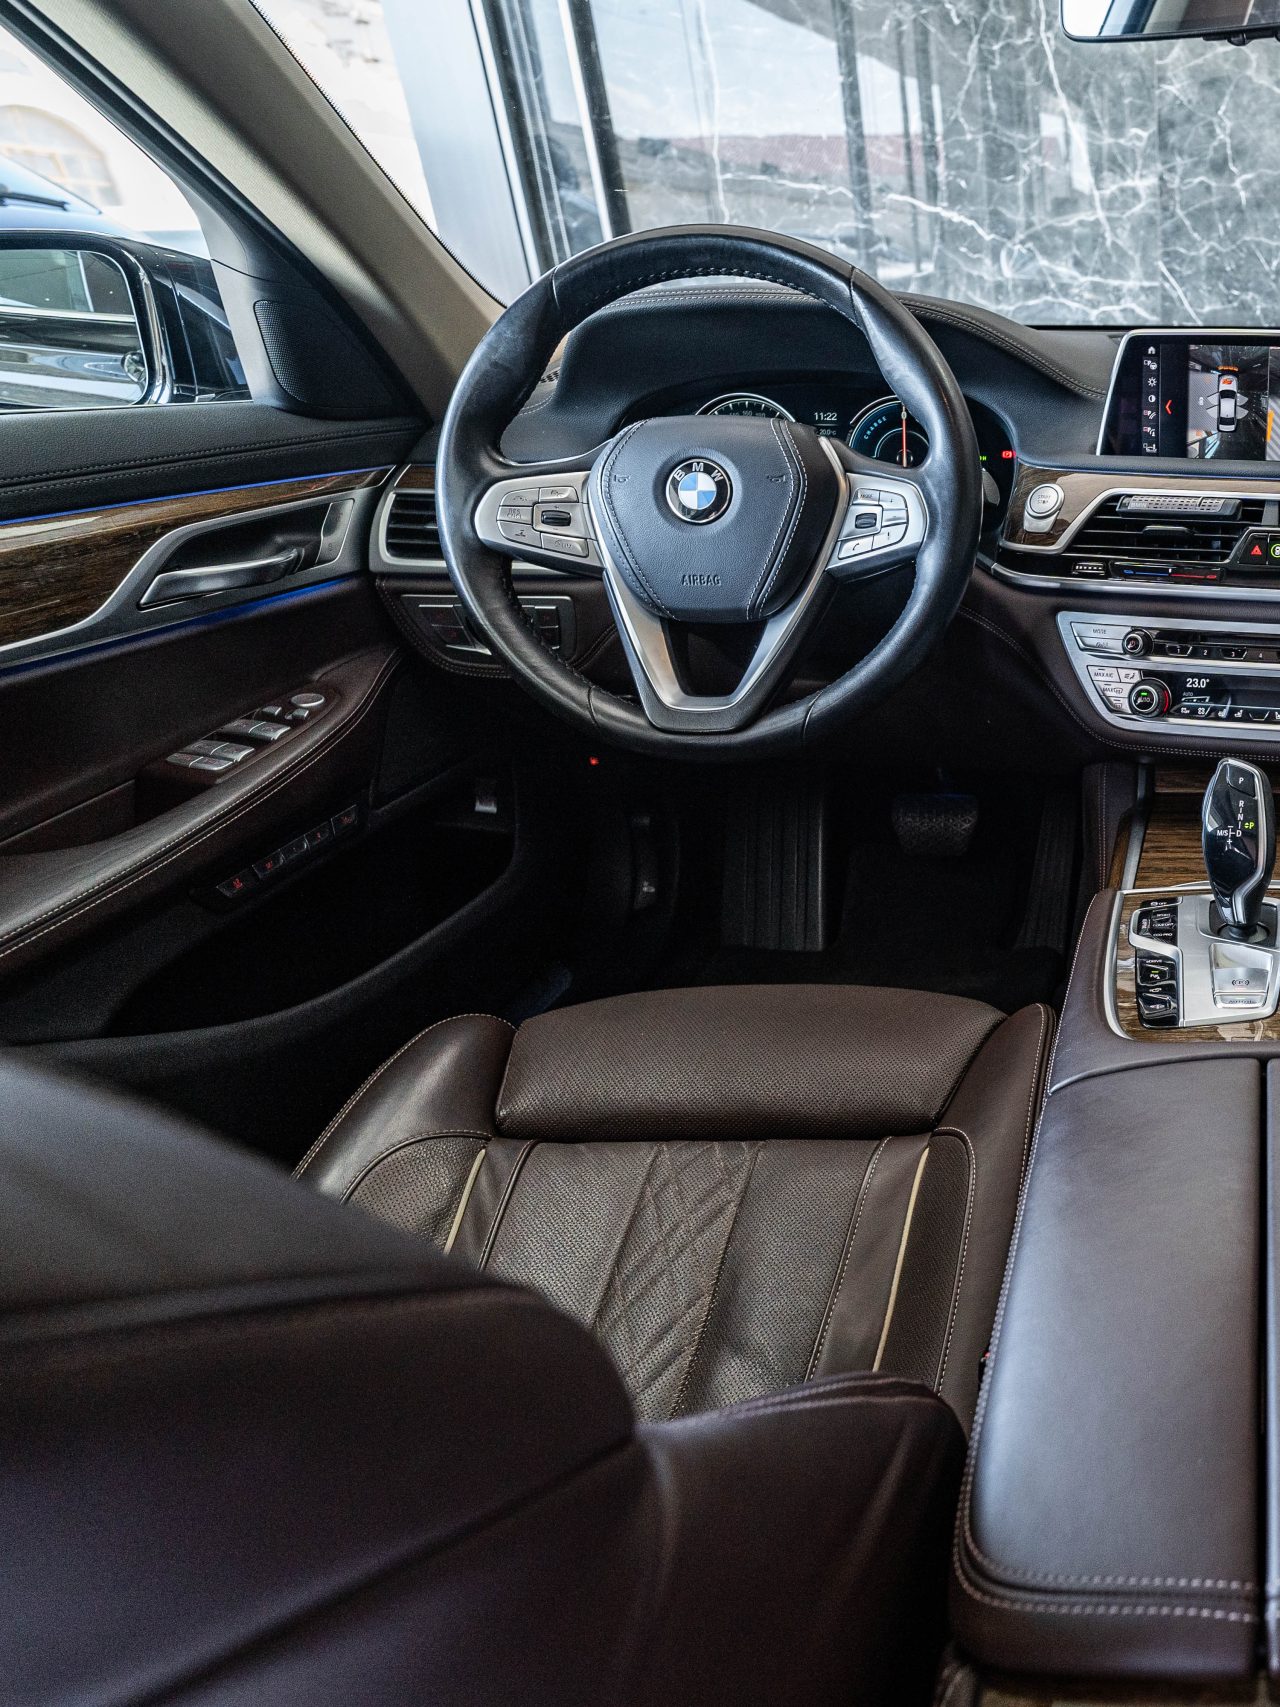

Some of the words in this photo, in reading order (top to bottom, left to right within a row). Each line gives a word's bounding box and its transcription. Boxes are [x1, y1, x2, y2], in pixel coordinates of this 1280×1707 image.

[814, 412, 838, 421] 11:22
[863, 415, 887, 440] CHARGE
[674, 462, 724, 482] BMW
[681, 574, 721, 586] AIRBAG
[1186, 678, 1210, 688] 23.0°
[1239, 800, 1245, 808] R
[1216, 829, 1229, 837] M/S
